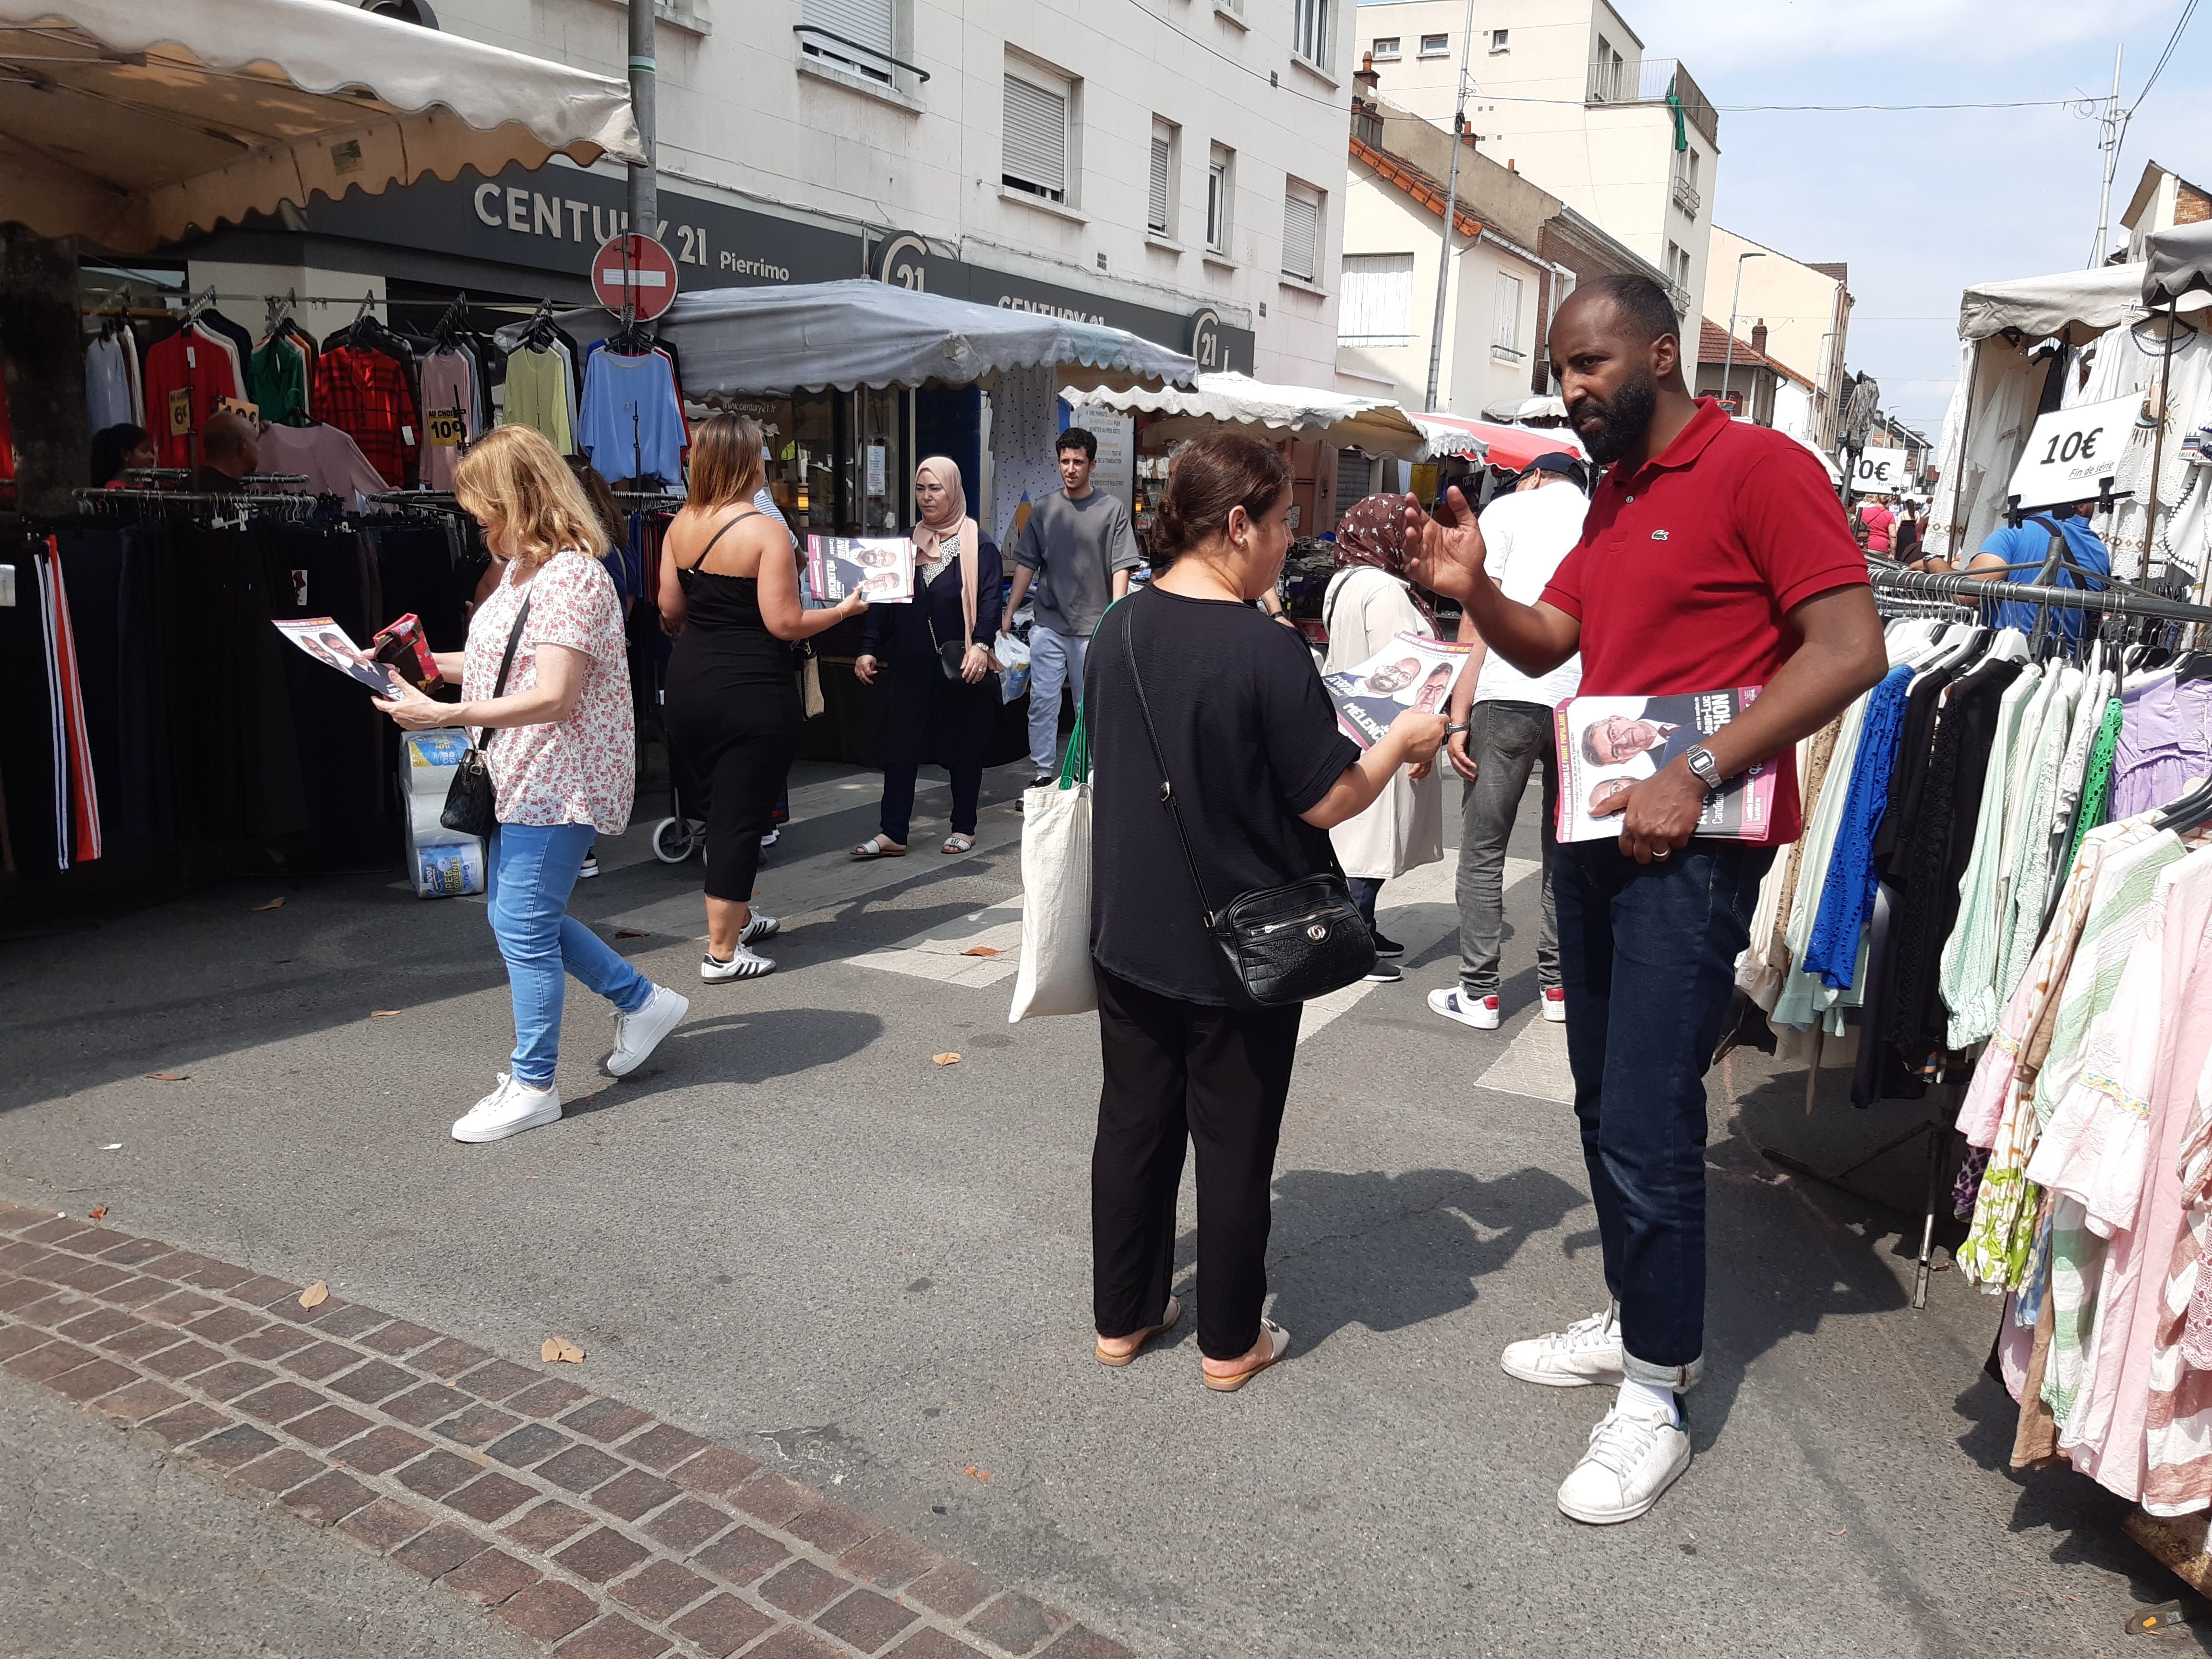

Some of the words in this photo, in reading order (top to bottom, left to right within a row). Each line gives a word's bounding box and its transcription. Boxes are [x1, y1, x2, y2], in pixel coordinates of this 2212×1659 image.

[474, 183, 669, 245] CENTU
[677, 225, 708, 266] 21
[720, 250, 790, 281] Pierrimo
[1200, 332, 1217, 367] 21
[722, 403, 776, 414] www.century21.fr
[431, 421, 460, 438] 10€
[2040, 427, 2104, 465] 10€
[1852, 459, 1891, 481] 0€
[2068, 468, 2083, 478] Fin
[2084, 465, 2094, 476] de
[2094, 460, 2115, 473] série
[836, 539, 846, 559] AWAD
[826, 560, 837, 599] MÉLENCHON
[1342, 702, 1385, 740] MÉLENC
[1558, 713, 1567, 744] POPULAIRE
[1701, 696, 1714, 736] Jean-Luc
[1561, 745, 1569, 763] FRONT
[1712, 793, 1724, 824] Candidat
